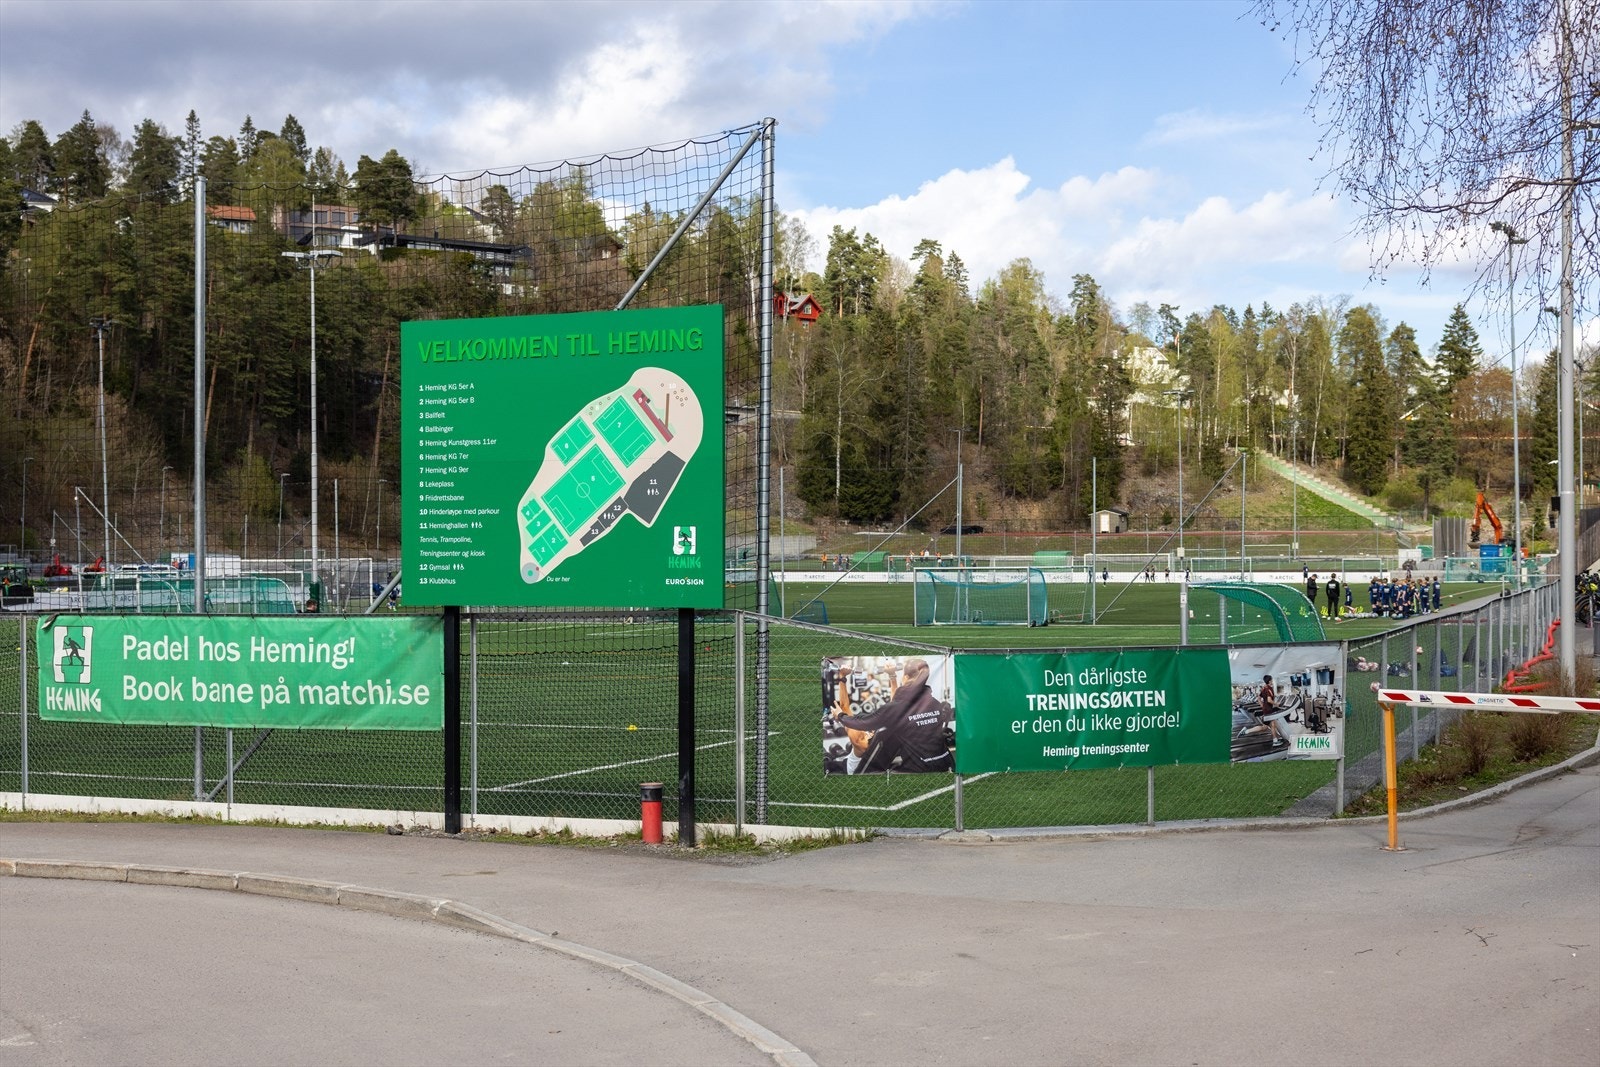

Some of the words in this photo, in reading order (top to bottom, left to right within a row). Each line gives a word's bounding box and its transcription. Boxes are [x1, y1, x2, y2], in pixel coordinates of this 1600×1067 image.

[418, 335, 558, 363] VELKOMMEN
[566, 333, 600, 356] TIL
[608, 327, 703, 354] HEMING
[668, 556, 701, 568] HEMING
[122, 635, 189, 661] Padel
[199, 636, 241, 662] hos
[249, 636, 356, 670] Heming!
[1044, 669, 1074, 687] Den
[1078, 667, 1147, 687] dårligste
[45, 687, 102, 712] HEMING
[122, 675, 184, 702] Book
[192, 676, 254, 704] bane
[260, 676, 291, 709] på
[298, 678, 430, 706] matchi.se
[1026, 690, 1166, 711] TRENINGSØKTEN
[916, 718, 938, 726] TRENER
[1011, 718, 1028, 734] er
[1032, 716, 1062, 733] den
[1066, 715, 1086, 732] du
[1091, 713, 1122, 731] ikke
[1126, 712, 1180, 732] gjorde!
[1043, 745, 1080, 758] Heming
[1082, 742, 1150, 756] treningssenter
[1297, 737, 1330, 748] HEMING
